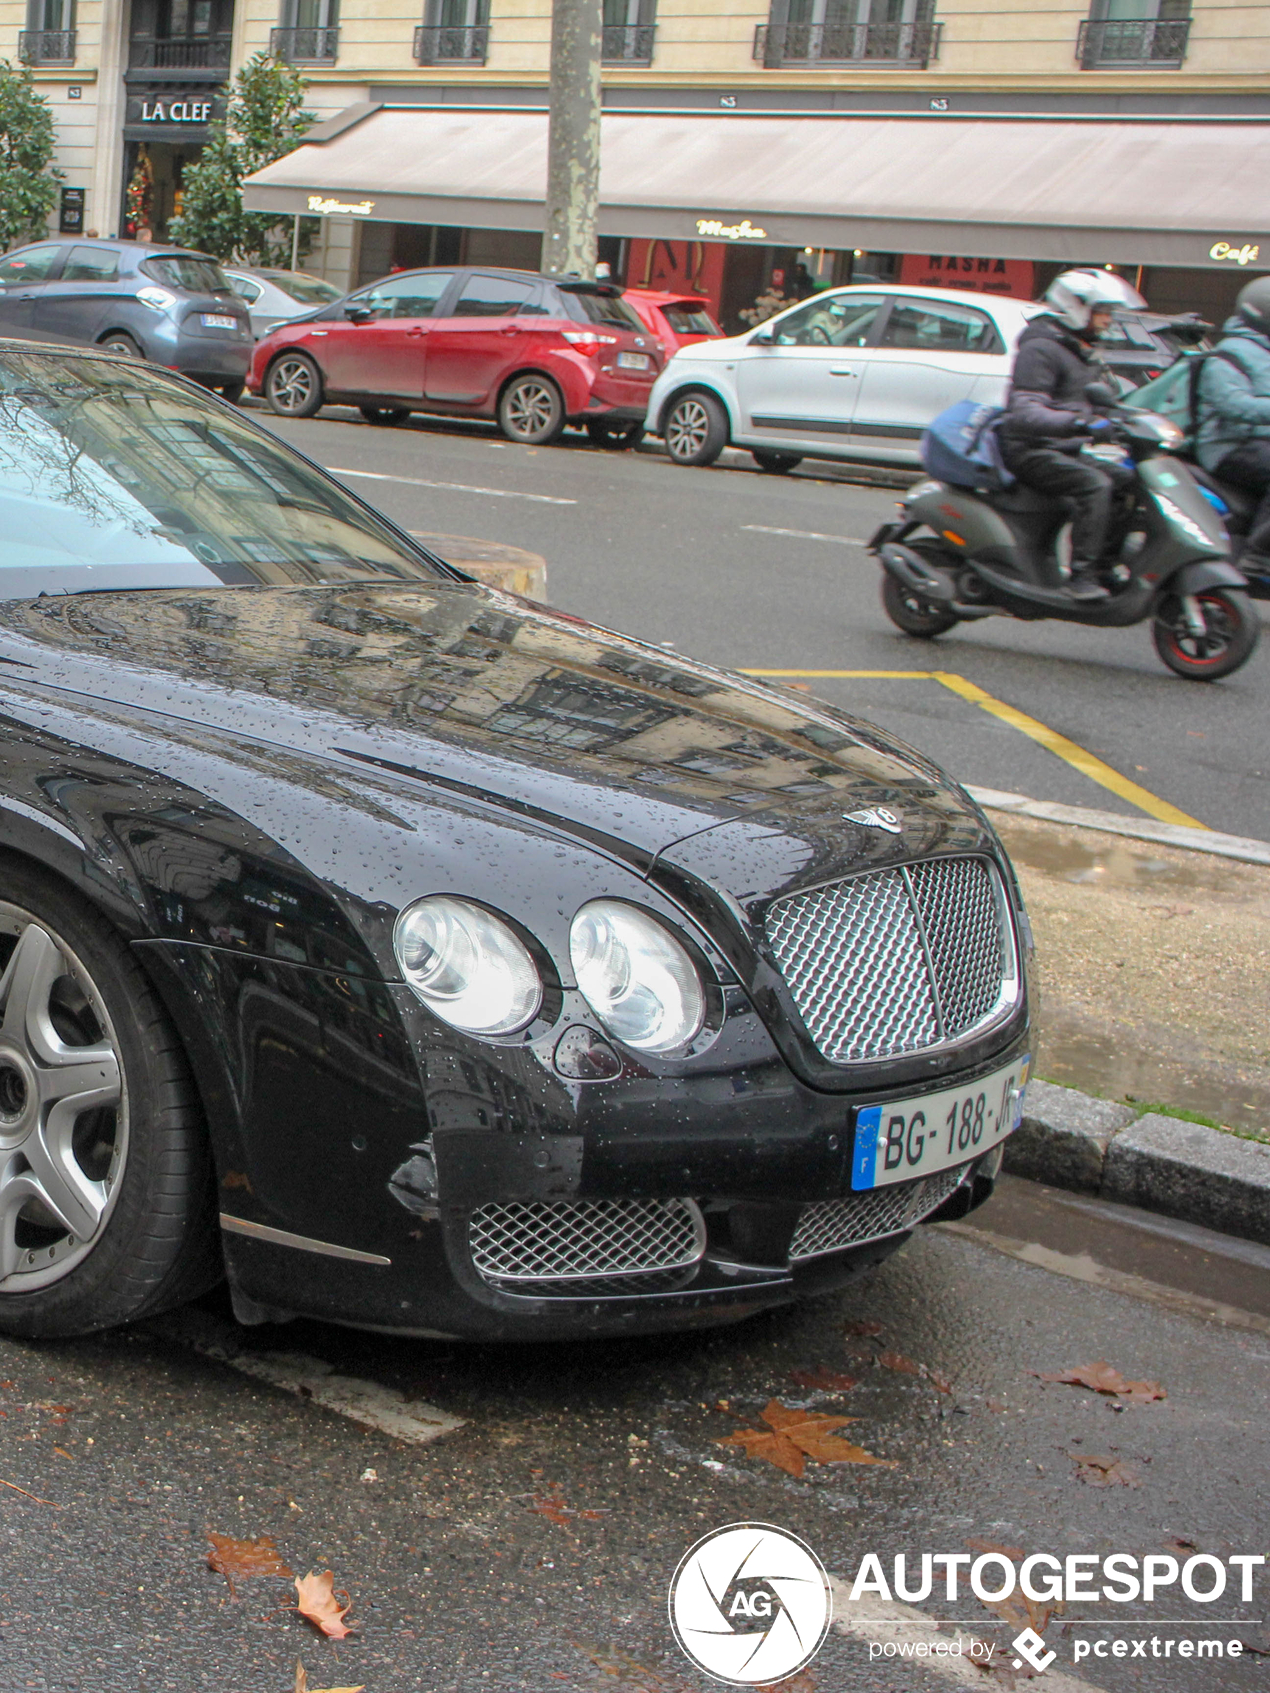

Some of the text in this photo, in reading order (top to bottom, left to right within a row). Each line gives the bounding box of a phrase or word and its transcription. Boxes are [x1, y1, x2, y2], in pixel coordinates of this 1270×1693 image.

[142, 101, 212, 122] LA CLEF
[1209, 241, 1260, 266] Café
[860, 1157, 869, 1174] F
